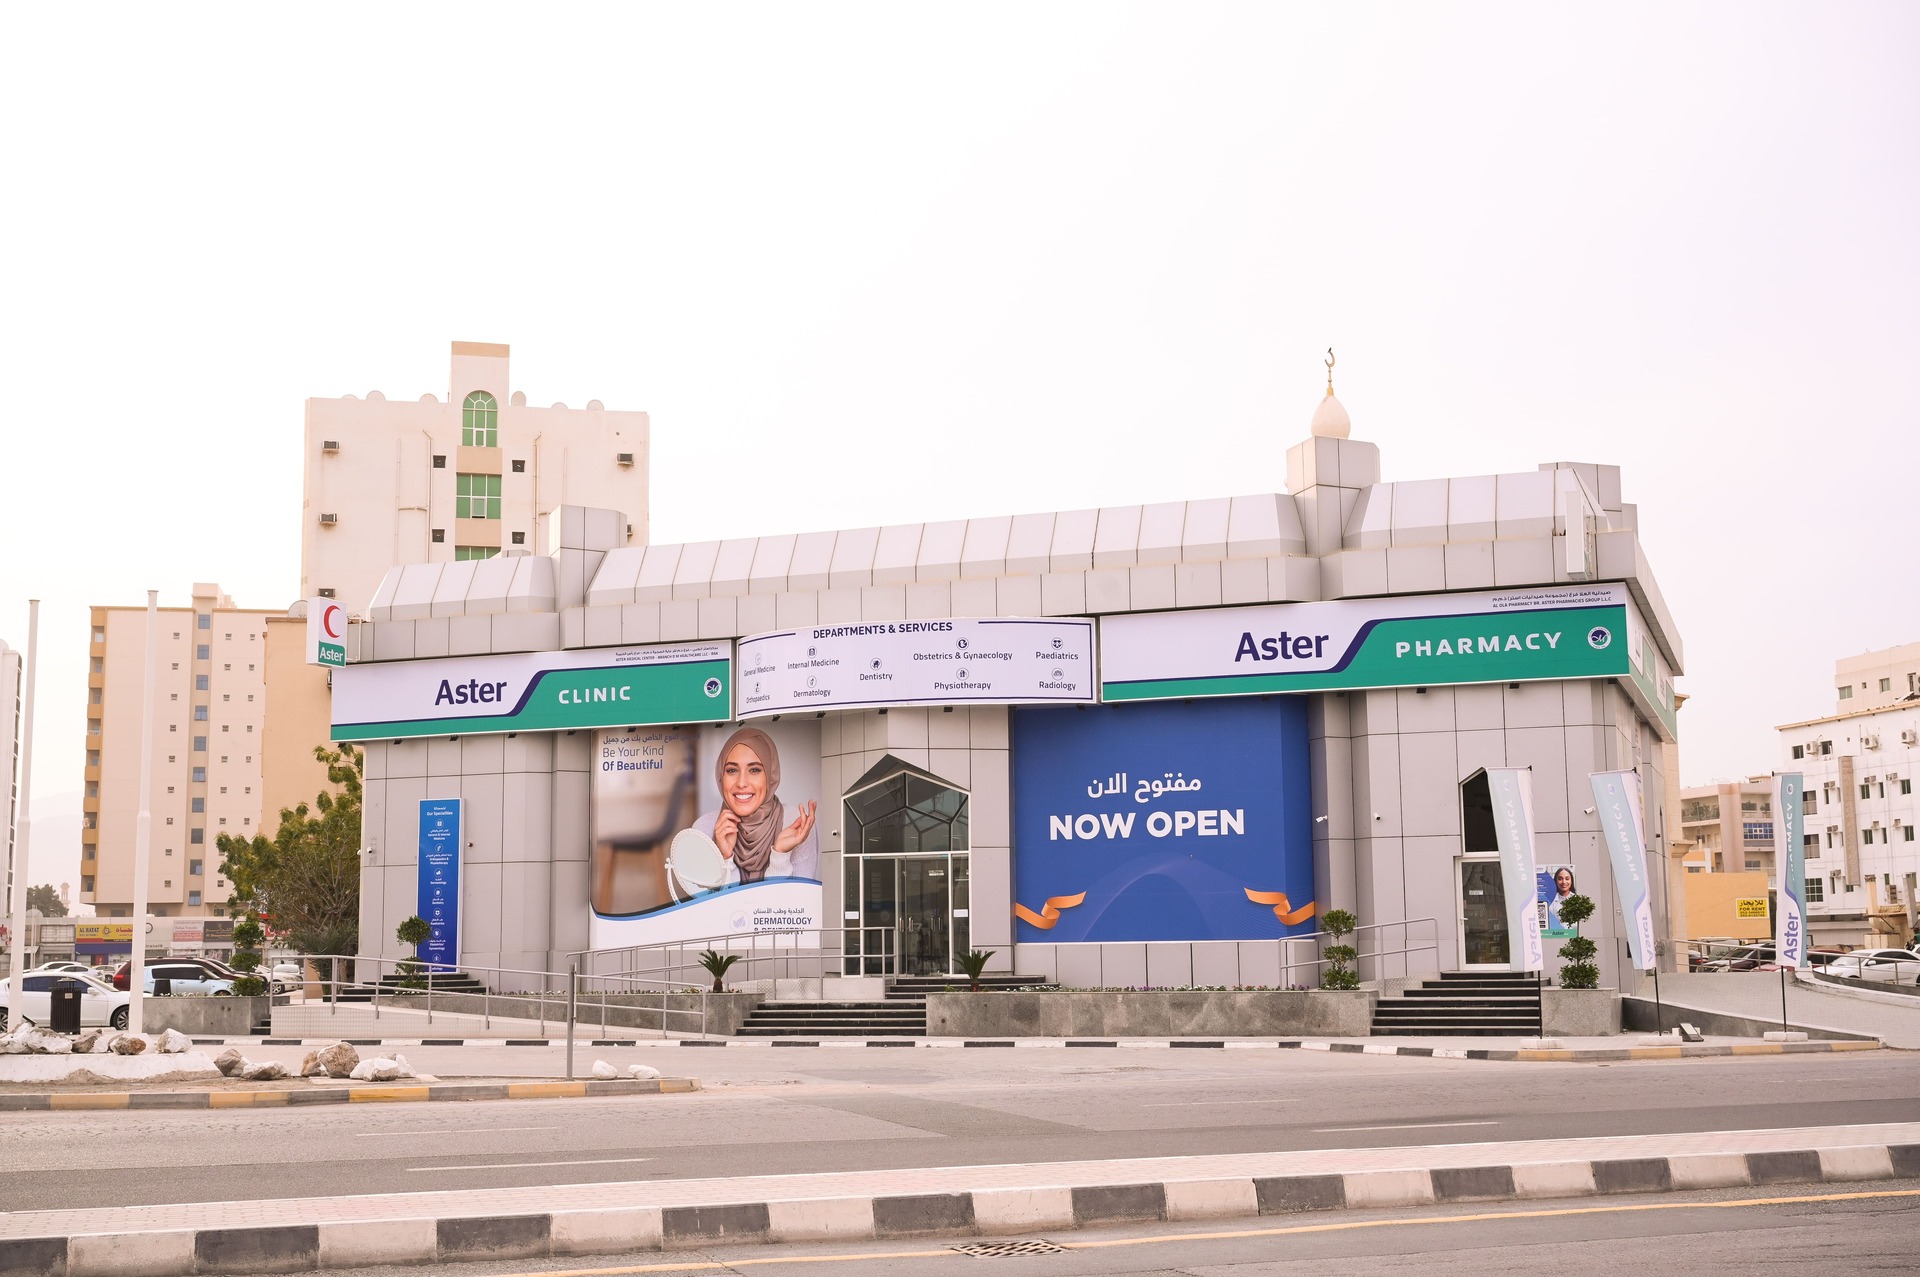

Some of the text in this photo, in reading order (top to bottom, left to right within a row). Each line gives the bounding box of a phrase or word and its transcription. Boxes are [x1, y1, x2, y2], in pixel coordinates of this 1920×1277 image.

[814, 622, 953, 639] DEPARTMENTS & SERVICES
[1234, 631, 1329, 662] Aster
[1396, 632, 1562, 658] PHARMACY
[320, 646, 343, 662] Aster
[913, 652, 952, 660] Obstetrics
[964, 652, 1013, 661] Gynaecology
[1036, 652, 1078, 660] Paediatrics
[811, 659, 840, 667] Medicine
[757, 665, 776, 674] Medicine
[860, 673, 892, 681] Dentistry
[934, 682, 991, 690] Physiotherapy
[1039, 681, 1076, 691] Radiology
[435, 679, 507, 706] Aster
[558, 686, 631, 704] CLINIC
[794, 689, 831, 698] Dermatology
[746, 694, 770, 704] Orthopaedics
[604, 736, 619, 745] جميل
[642, 734, 662, 742] الخاص
[603, 745, 664, 757] Be Your Kind
[602, 759, 663, 771] Of Beautiful
[1088, 772, 1202, 803] مفتوح الان
[1050, 809, 1244, 840] NOW OPEN
[754, 917, 812, 925] DERMATOLOGY
[1784, 912, 1798, 961] Aster
